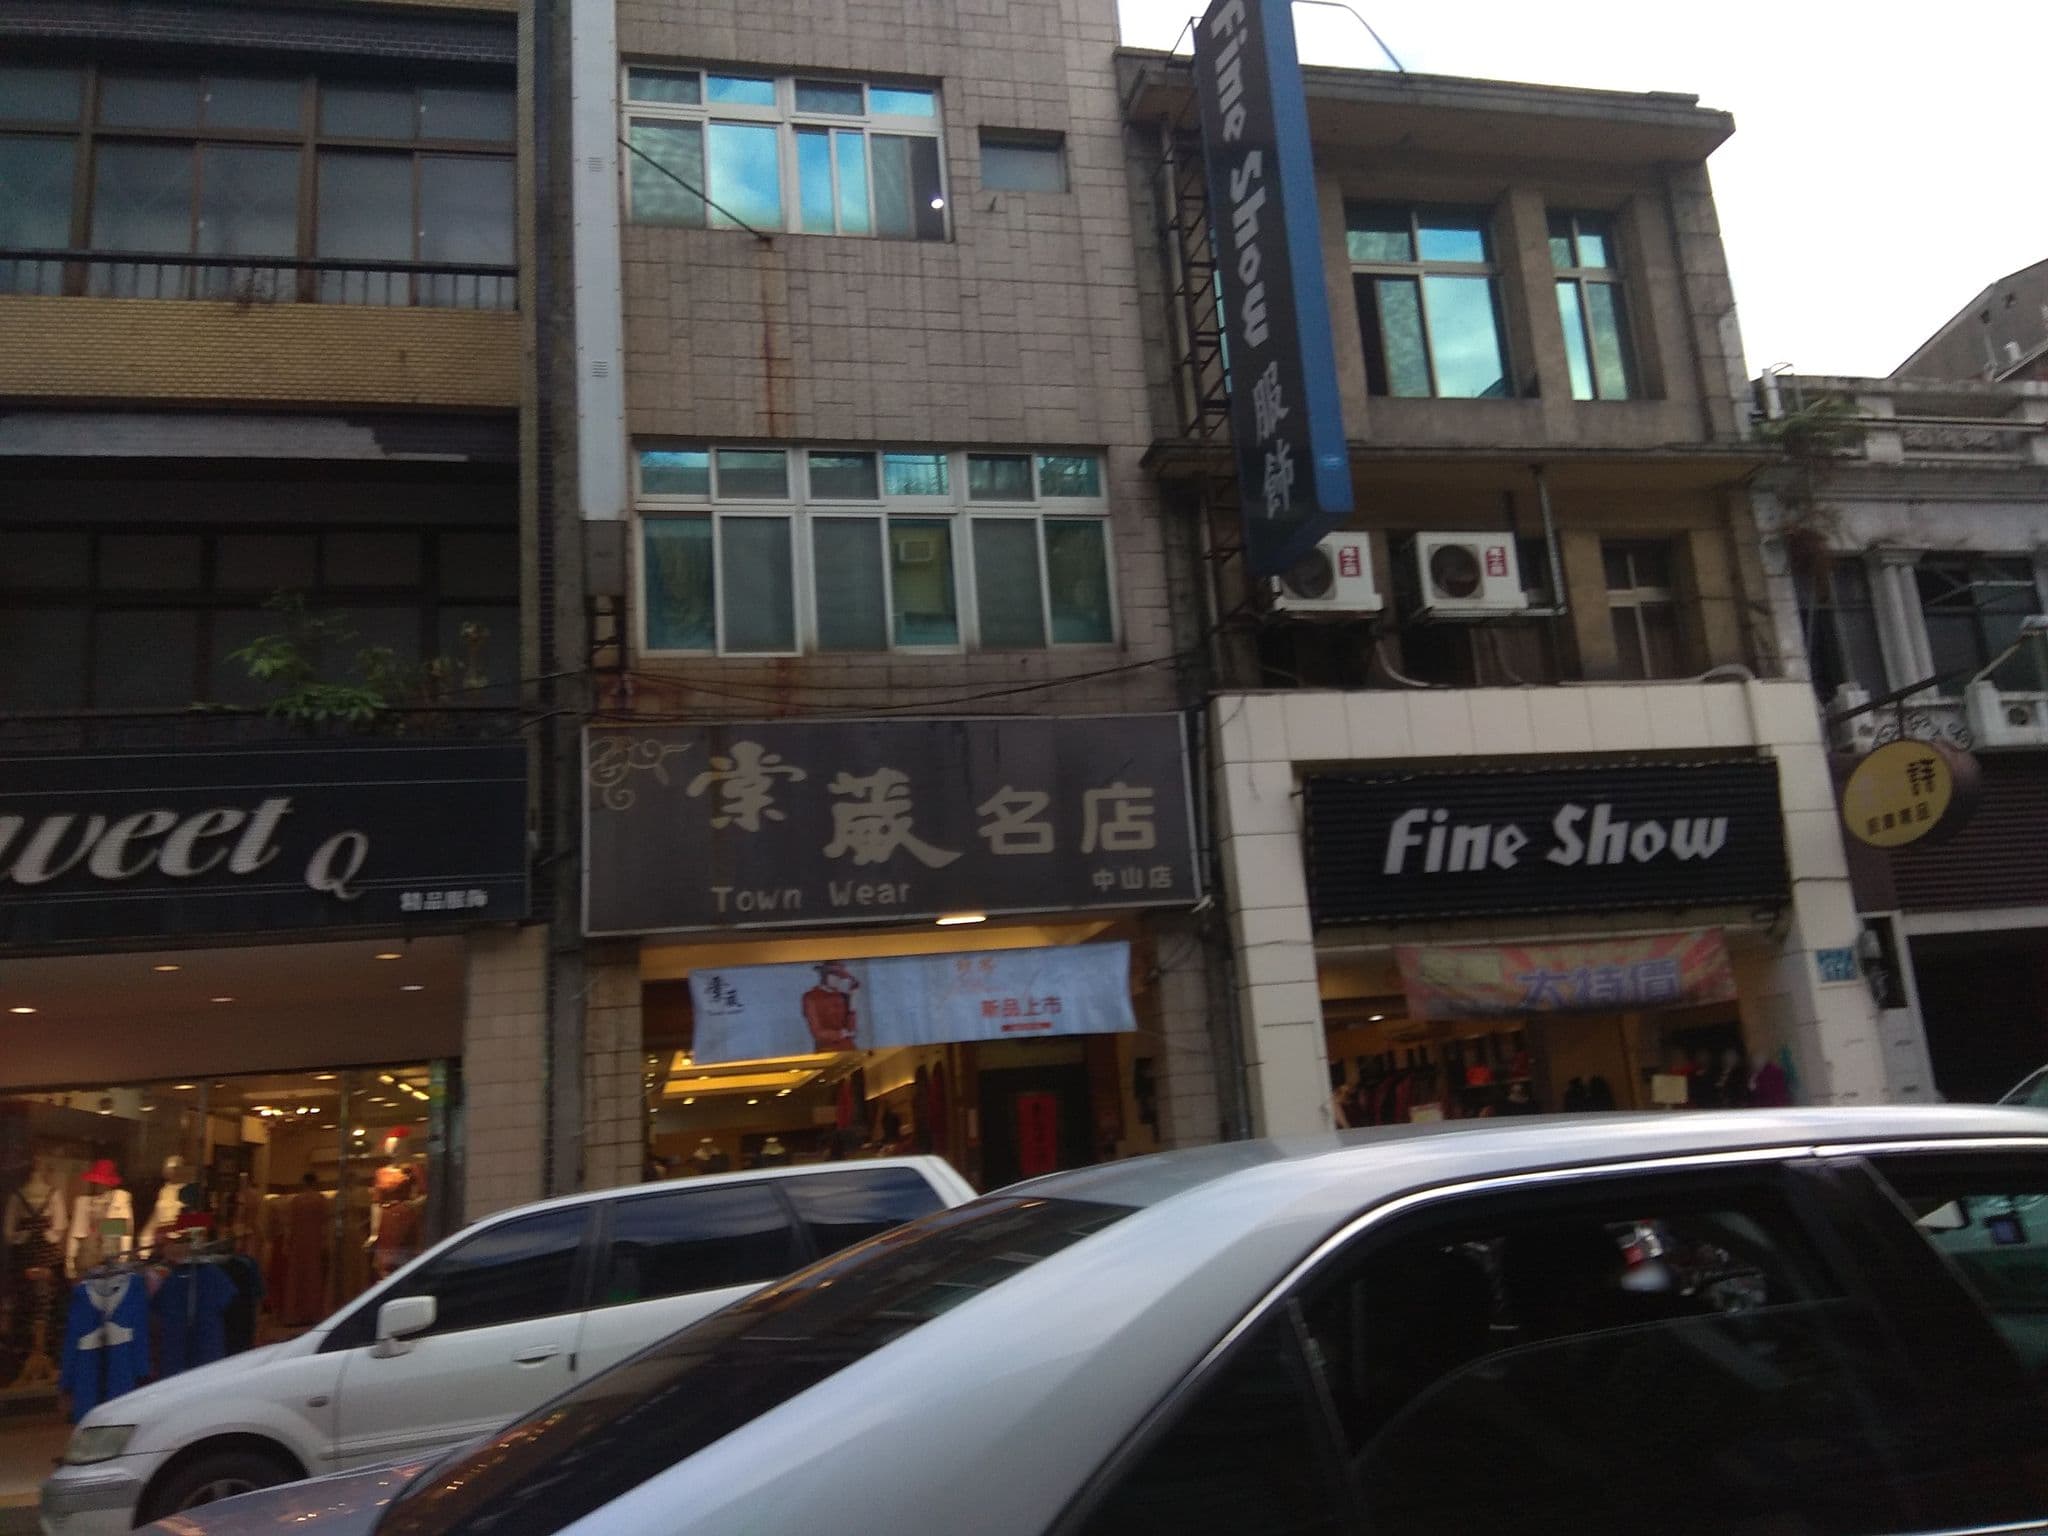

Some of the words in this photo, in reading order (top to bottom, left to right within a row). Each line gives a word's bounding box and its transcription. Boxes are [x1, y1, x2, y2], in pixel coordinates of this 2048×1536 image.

[1230, 150, 1269, 348] Show
[304, 831, 370, 899] Q
[1384, 808, 1529, 874] Fine
[1546, 803, 1728, 867] Show
[712, 884, 801, 913] Town
[829, 880, 911, 908] Wear
[1092, 866, 1173, 892] 中山店
